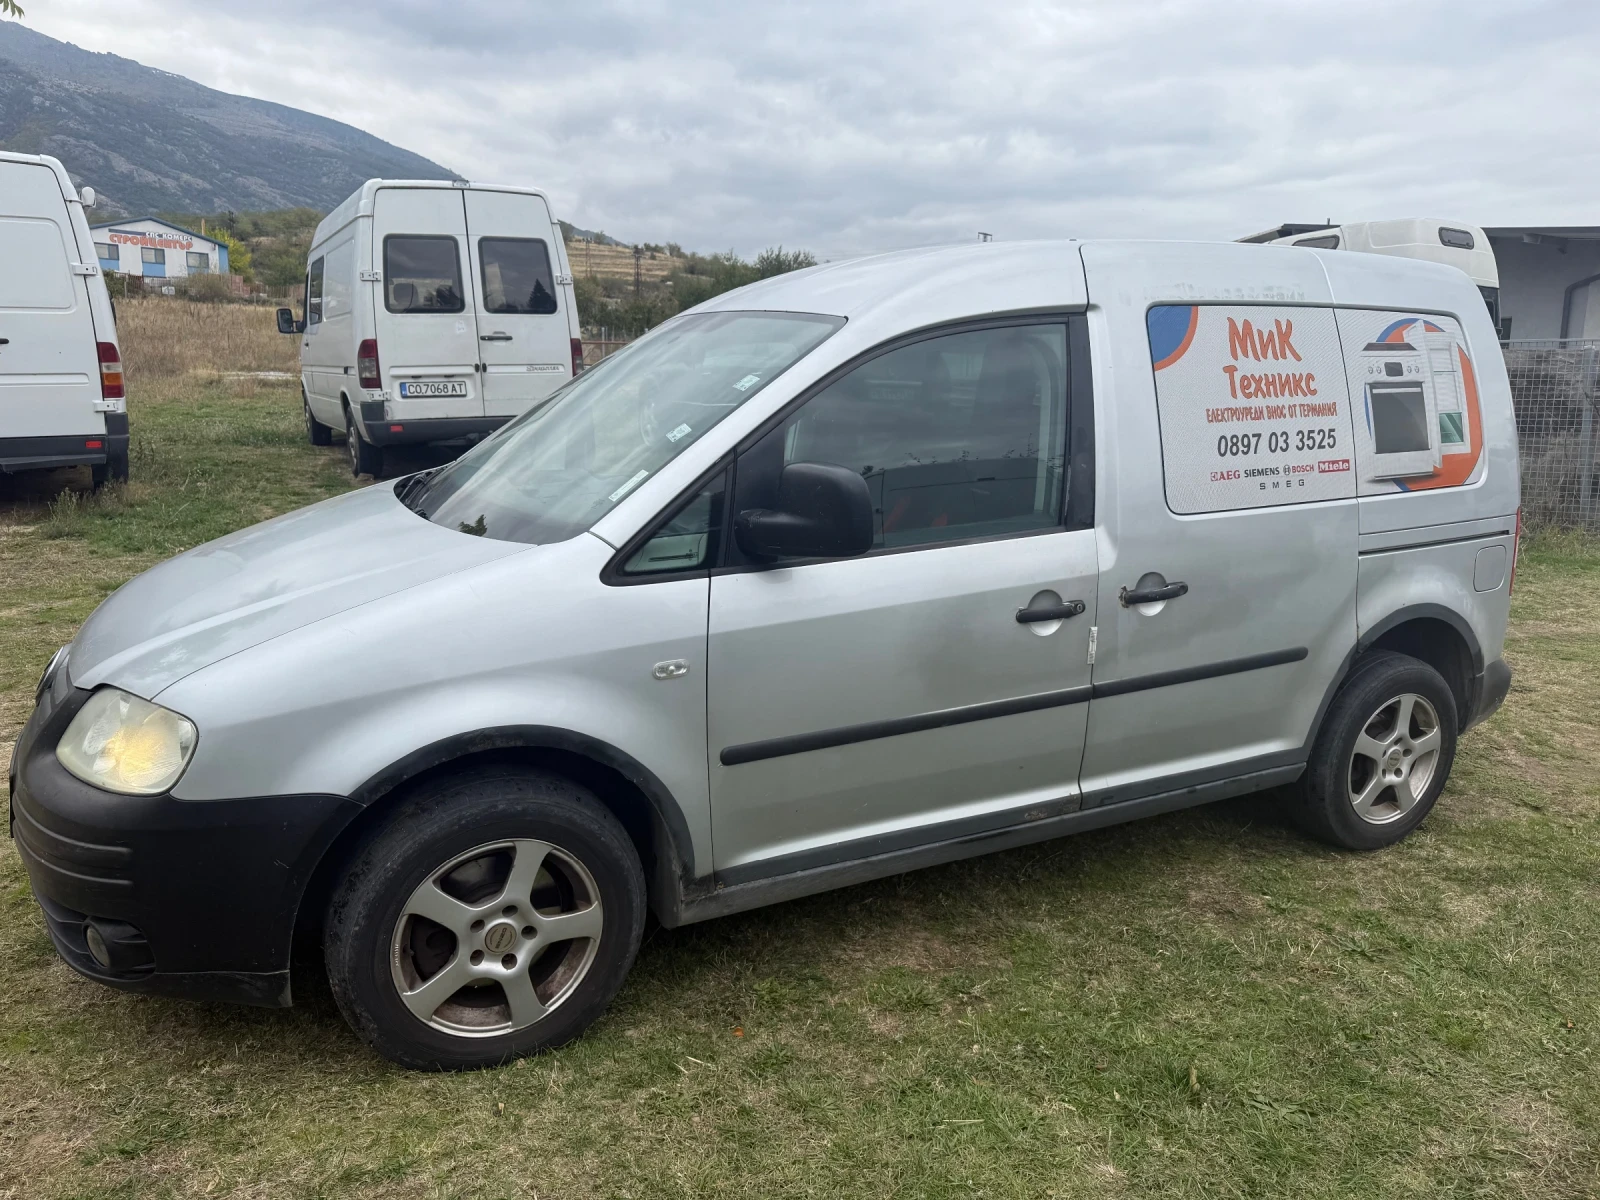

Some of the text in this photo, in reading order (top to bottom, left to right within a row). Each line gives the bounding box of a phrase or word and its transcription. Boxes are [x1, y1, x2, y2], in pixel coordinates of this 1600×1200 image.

[109, 233, 194, 251] СТРОЙЦЕНТЪР
[1222, 364, 1318, 400] Техникс
[1205, 401, 1338, 424] ЕЛЕКТРОУРЕДИ ВНОС ОТ ГЕРМАНИЯ
[1217, 428, 1337, 457] 0897 03 3525
[1244, 466, 1280, 478] SIEMENS
[1291, 463, 1315, 474] BOSCH
[1318, 460, 1350, 473] Miele
